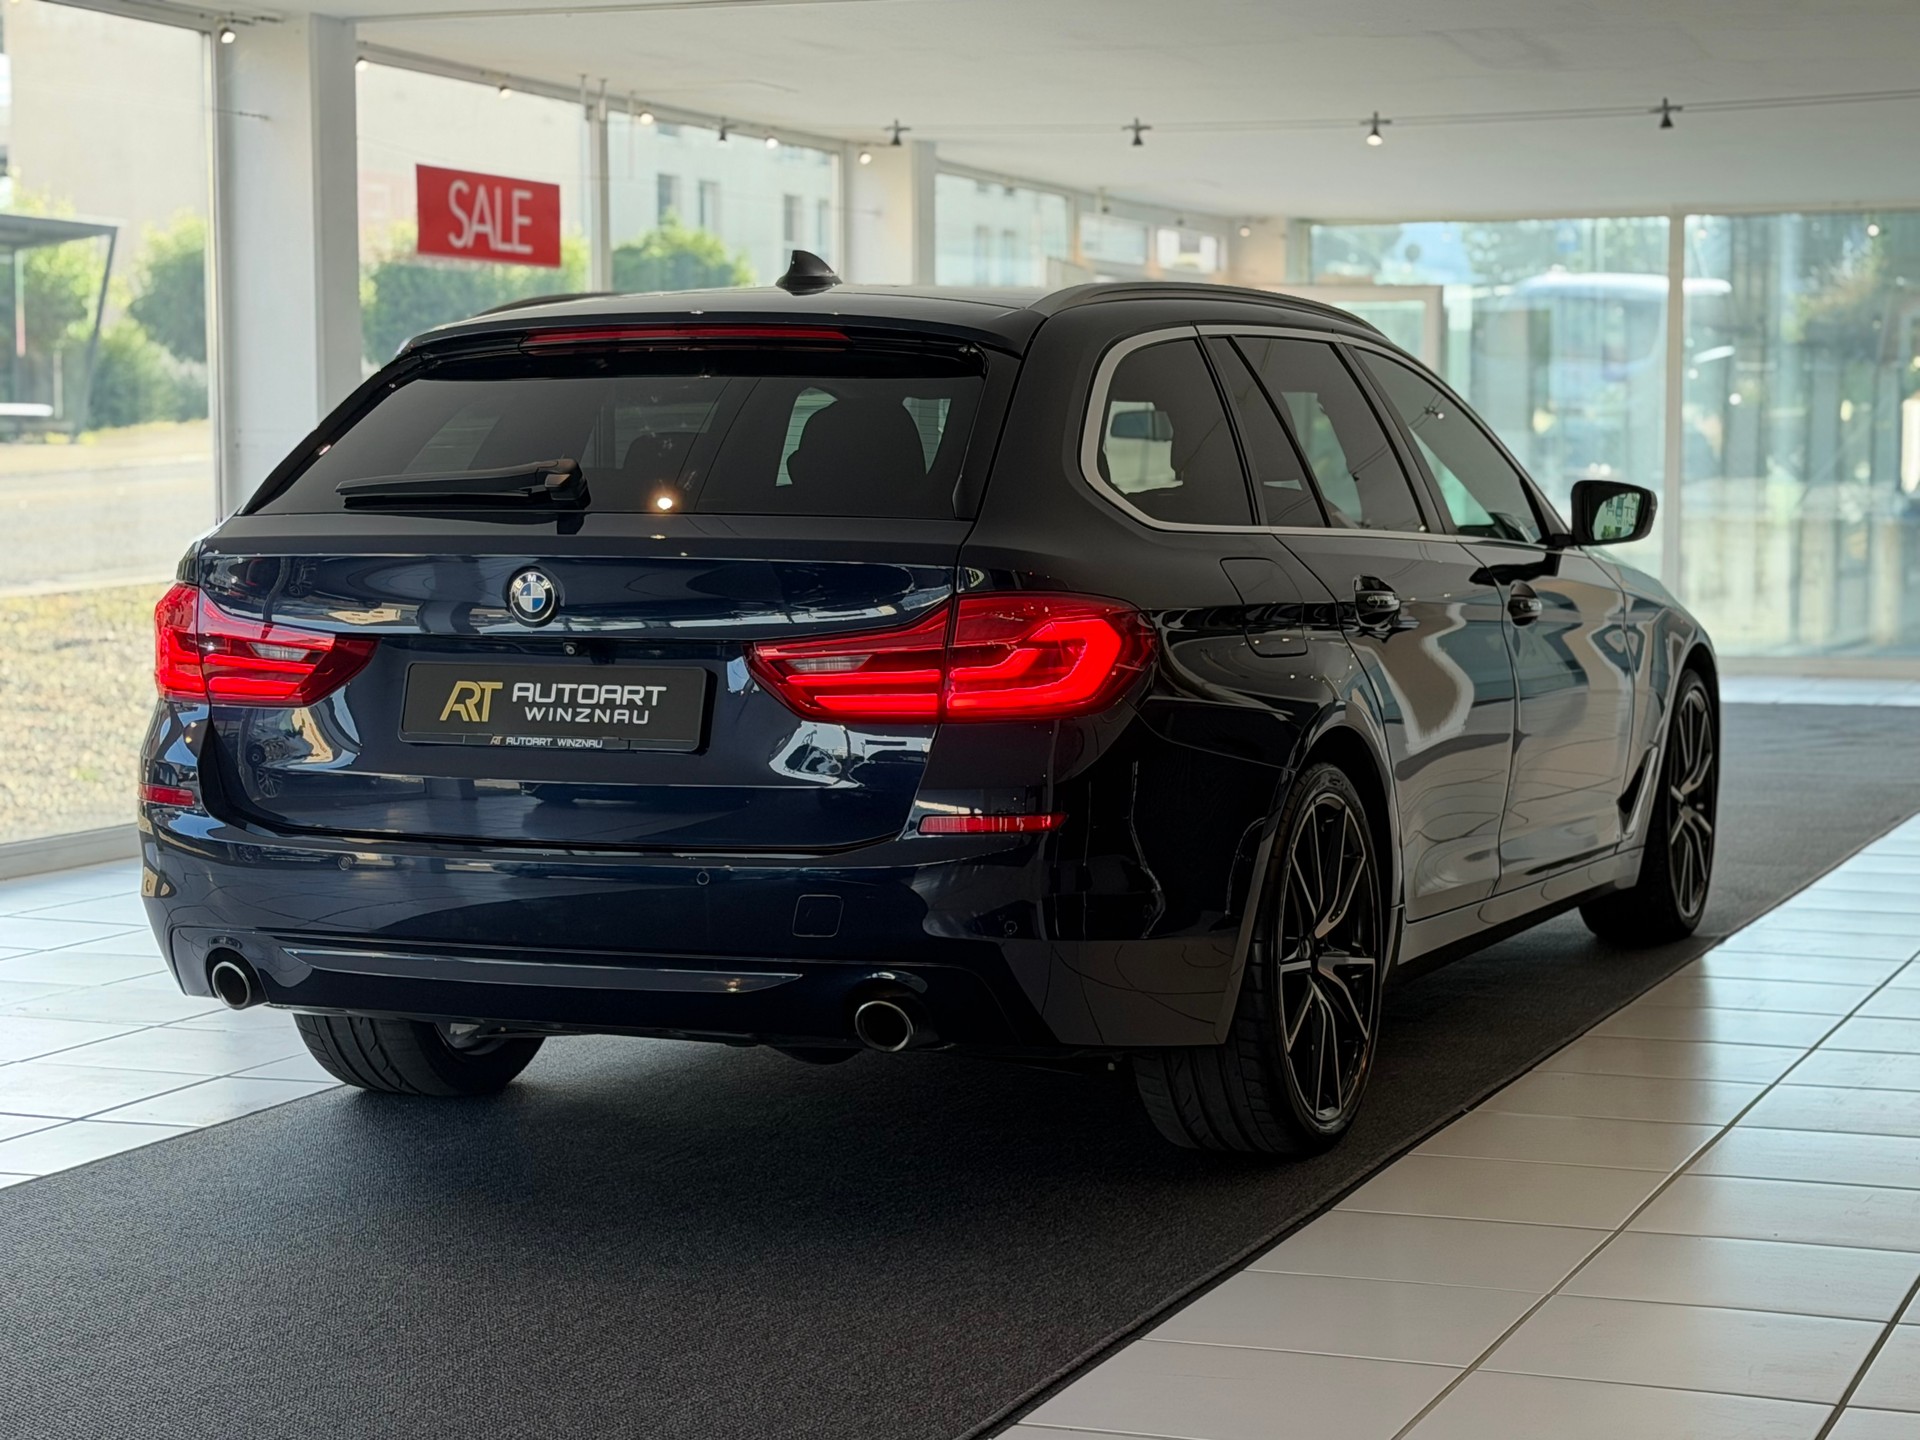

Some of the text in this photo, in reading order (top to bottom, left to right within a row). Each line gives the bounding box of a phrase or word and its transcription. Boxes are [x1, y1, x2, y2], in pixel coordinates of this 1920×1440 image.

[447, 178, 534, 255] SALE
[511, 682, 667, 706] AUTOART
[524, 706, 649, 725] WINZNAU
[505, 736, 554, 747] AUTOART
[556, 737, 603, 749] WINZNAU
